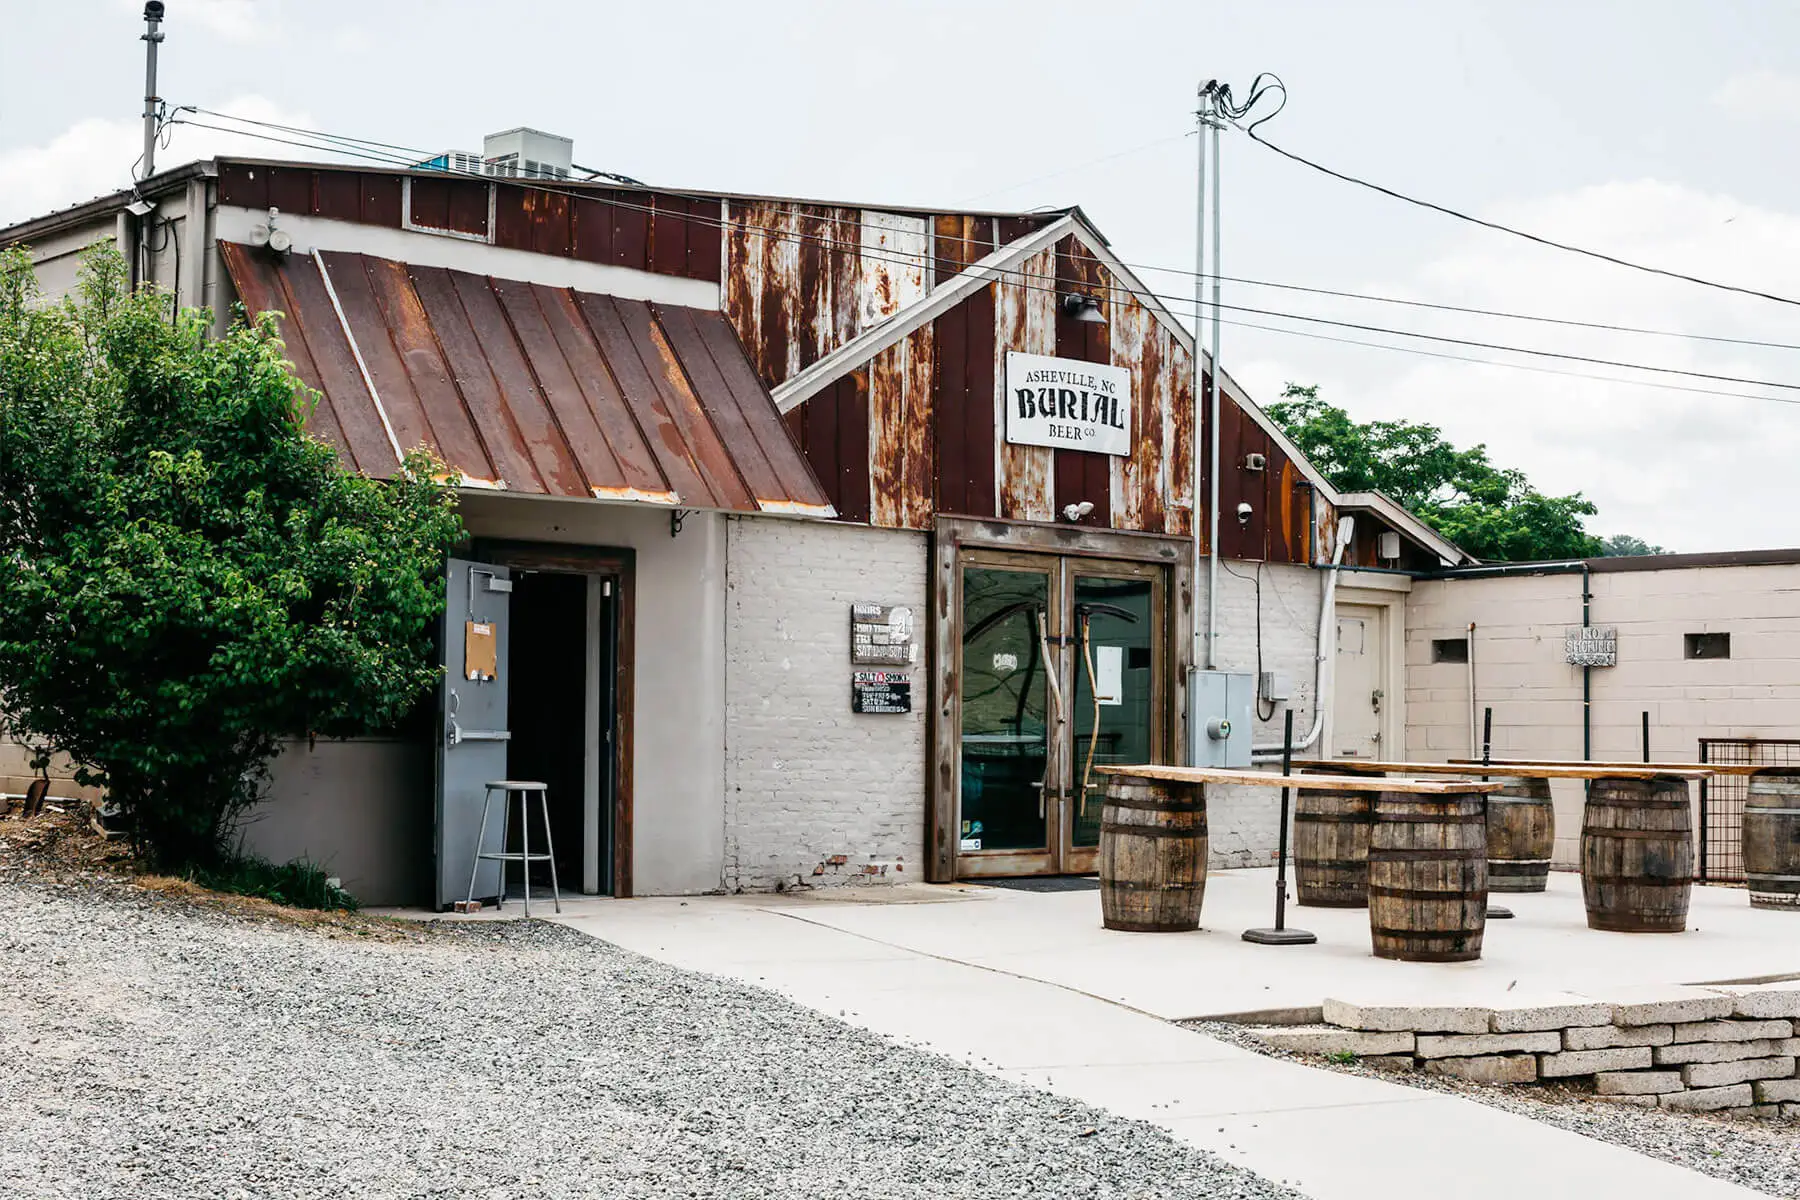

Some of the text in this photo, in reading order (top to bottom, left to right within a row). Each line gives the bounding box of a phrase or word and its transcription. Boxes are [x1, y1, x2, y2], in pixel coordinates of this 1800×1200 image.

[1026, 370, 1116, 394] ASHEVILLE, NC
[1014, 387, 1125, 430] BURIAL
[1048, 424, 1082, 440] BEER
[1565, 640, 1616, 653] SMOKING
[859, 672, 875, 681] SALT
